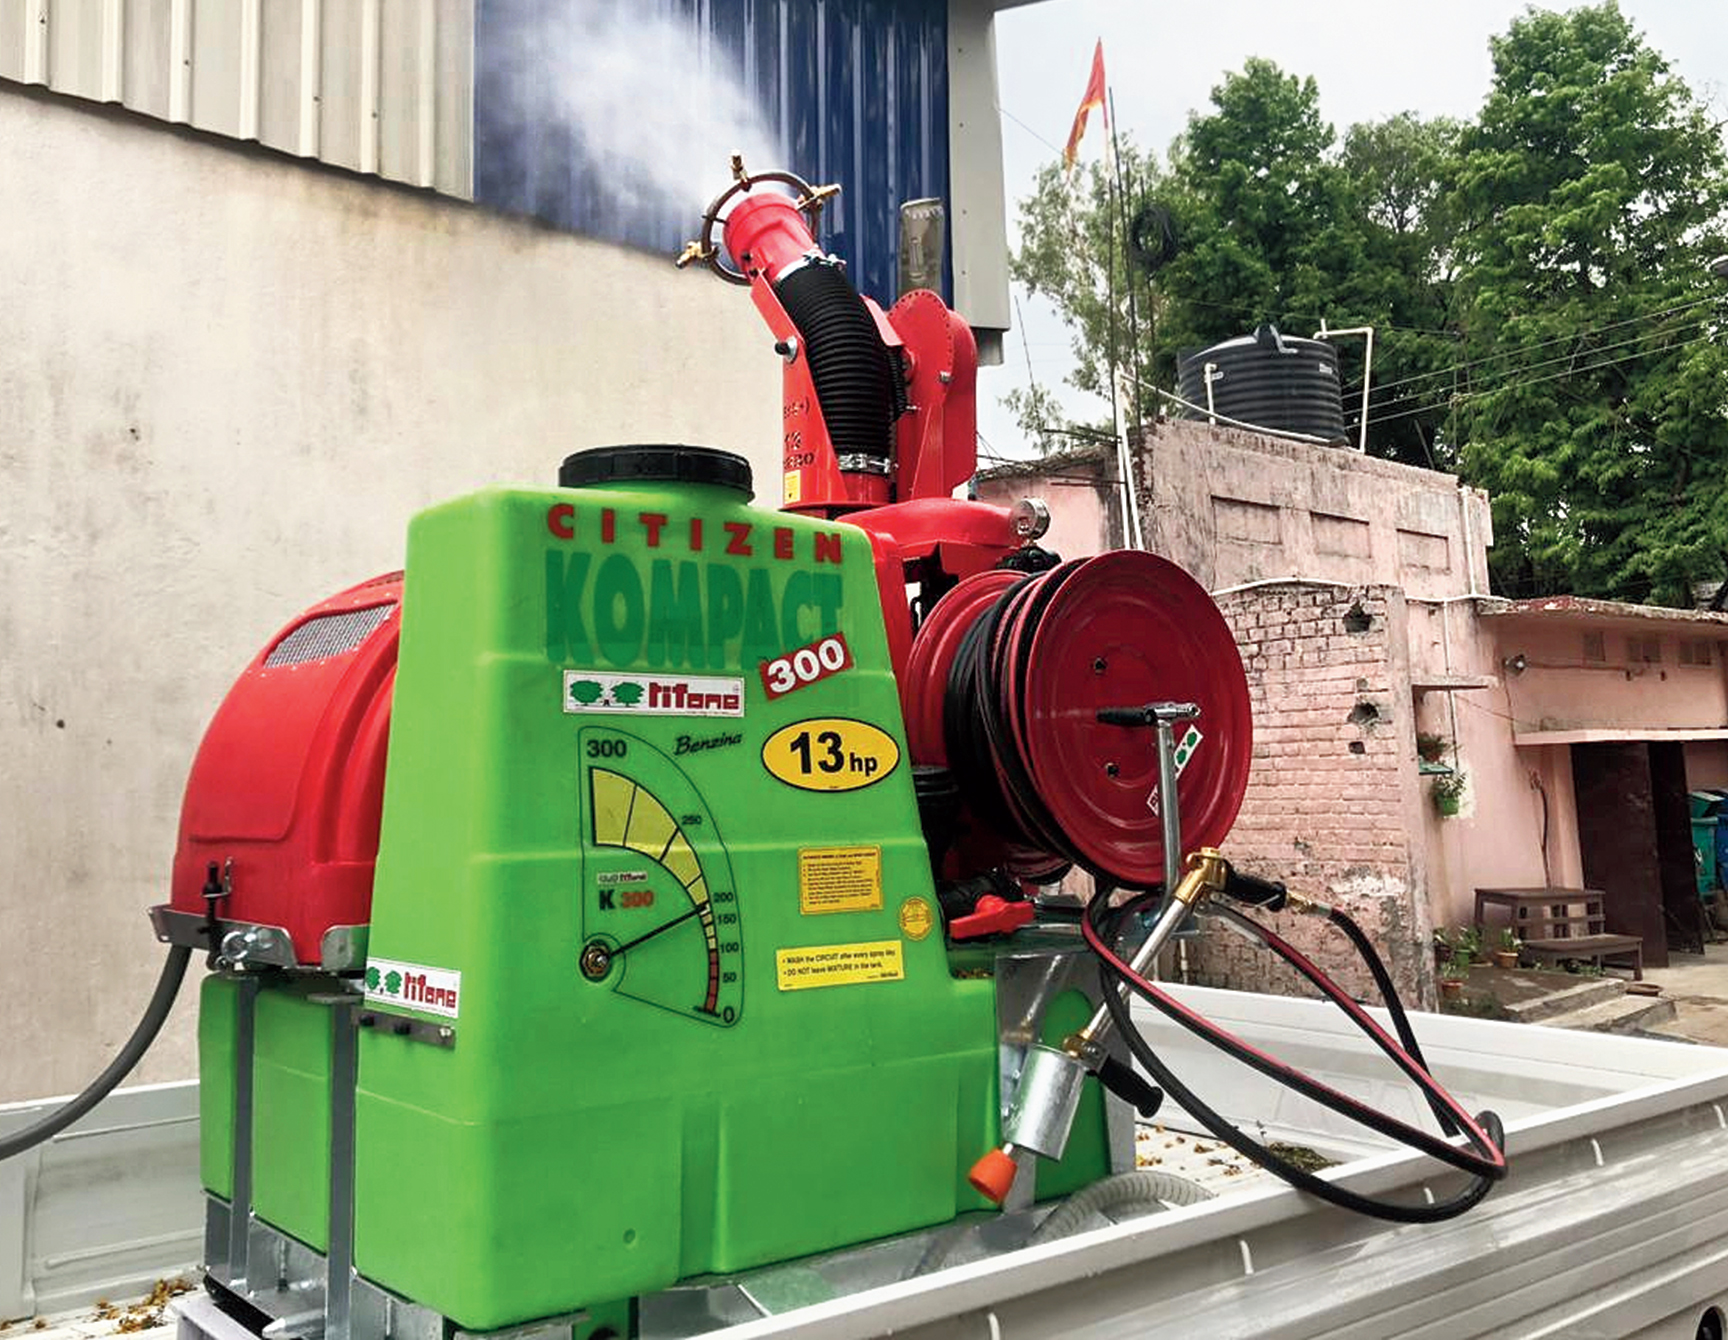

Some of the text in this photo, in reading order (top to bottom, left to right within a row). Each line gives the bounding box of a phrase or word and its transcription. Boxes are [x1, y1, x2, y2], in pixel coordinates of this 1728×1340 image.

[547, 503, 842, 564] CITIZEN
[545, 549, 843, 670] KOMPACT
[768, 639, 844, 692] 300
[587, 739, 627, 757] 300
[674, 733, 742, 755] Benzina
[790, 731, 877, 776] 13 hp
[682, 815, 701, 825] 250
[599, 889, 615, 910] K
[713, 892, 733, 902] 200
[718, 914, 736, 924] 150
[720, 942, 739, 953] 100
[723, 972, 737, 983] 50
[723, 1006, 735, 1023] 0
